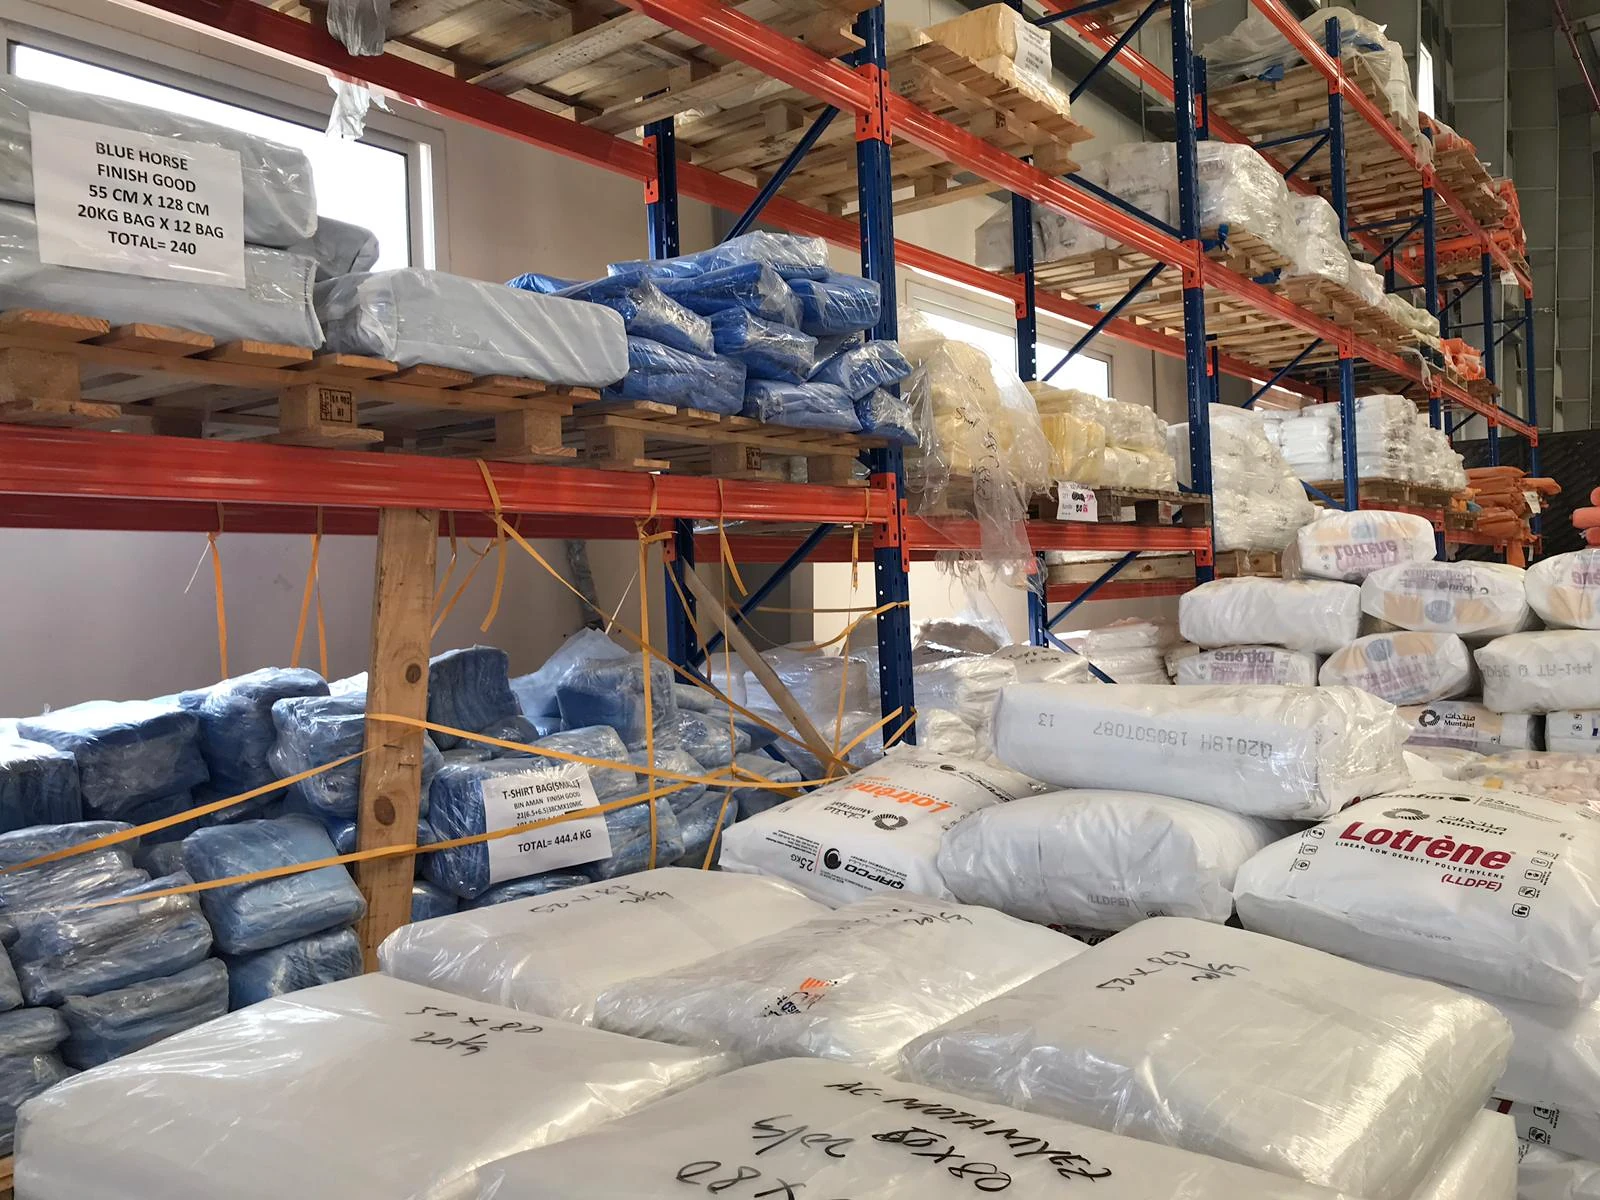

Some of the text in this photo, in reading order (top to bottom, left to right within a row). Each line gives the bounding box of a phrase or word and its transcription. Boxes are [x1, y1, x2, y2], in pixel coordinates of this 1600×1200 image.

[95, 142, 189, 171] BLUE HORSE
[97, 163, 196, 193] FINISH GOOD
[88, 184, 210, 216] 55 CM X 128 CM
[77, 204, 224, 239] 20KG BAG X 12 BAG
[108, 230, 197, 255] TOTAL= 240
[1037, 712, 1055, 728] 13
[1443, 719, 1475, 729] Muntajat
[502, 786, 534, 800] T-SHIRT
[1435, 818, 1506, 837] Muntajat
[518, 829, 592, 853] TOTAL= 444.4 KG
[1339, 821, 1512, 871] Lotrène
[790, 853, 815, 873] 25KG
[1335, 841, 1506, 880] LINEAR LOW DENSITY POLYETHYLENE
[844, 863, 905, 890] QAPCO
[1440, 872, 1503, 893] (LLDPE)
